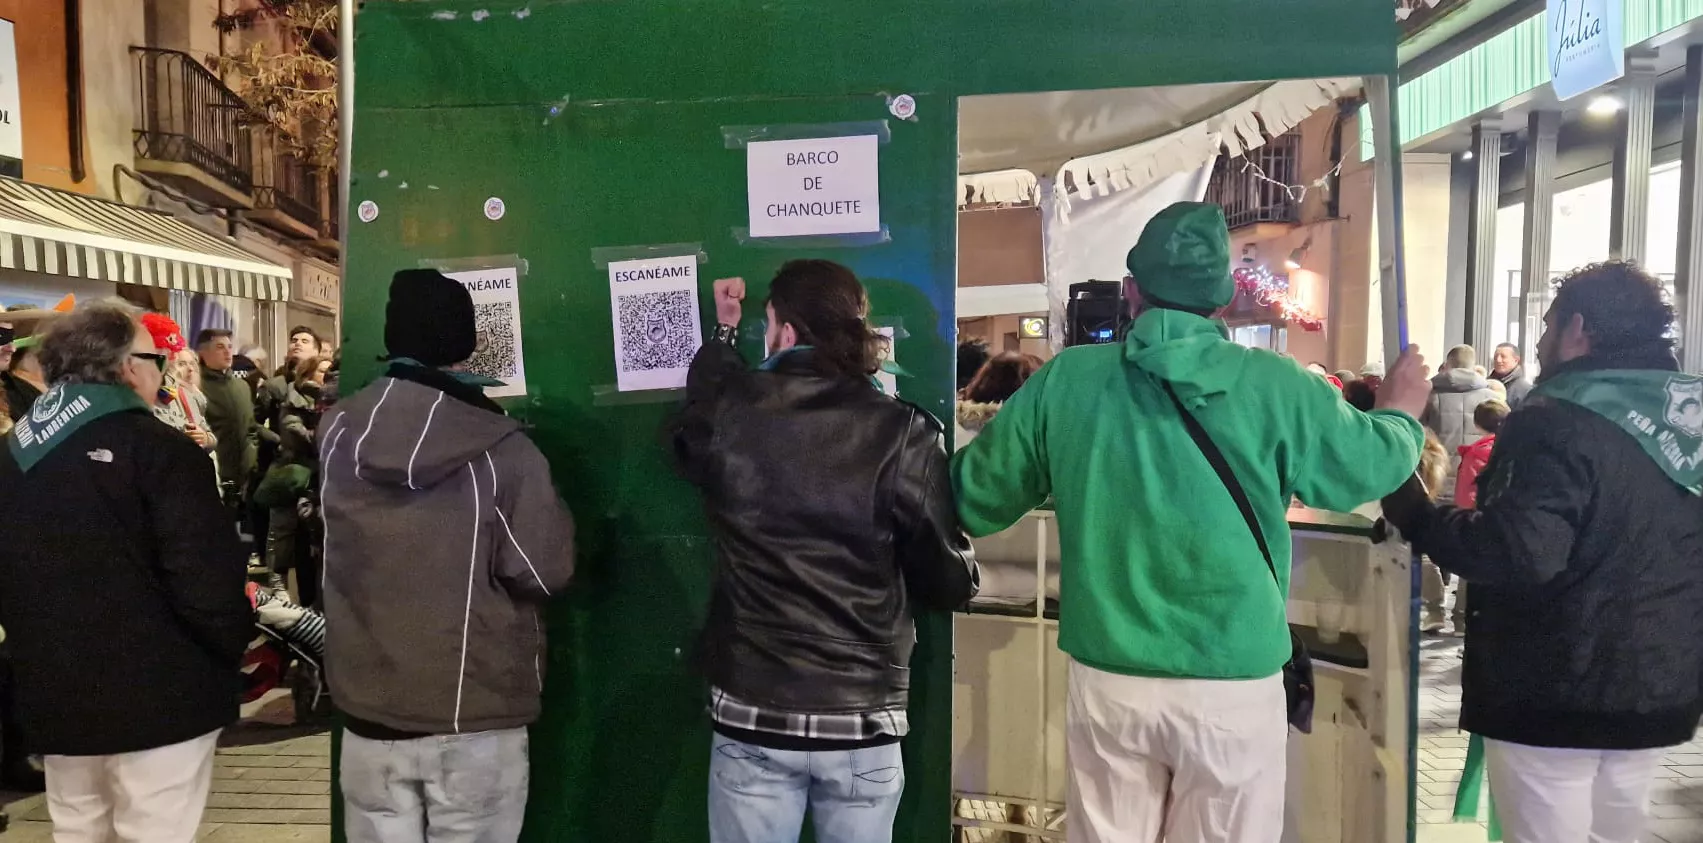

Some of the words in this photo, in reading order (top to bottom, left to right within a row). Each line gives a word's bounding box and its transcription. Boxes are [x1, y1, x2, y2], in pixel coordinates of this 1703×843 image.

[786, 150, 839, 166] BARCO
[803, 176, 823, 191] DE
[766, 200, 862, 217] CHANQUETE
[615, 265, 692, 283] ESCANÉAME
[34, 394, 92, 445] LAURENTINA
